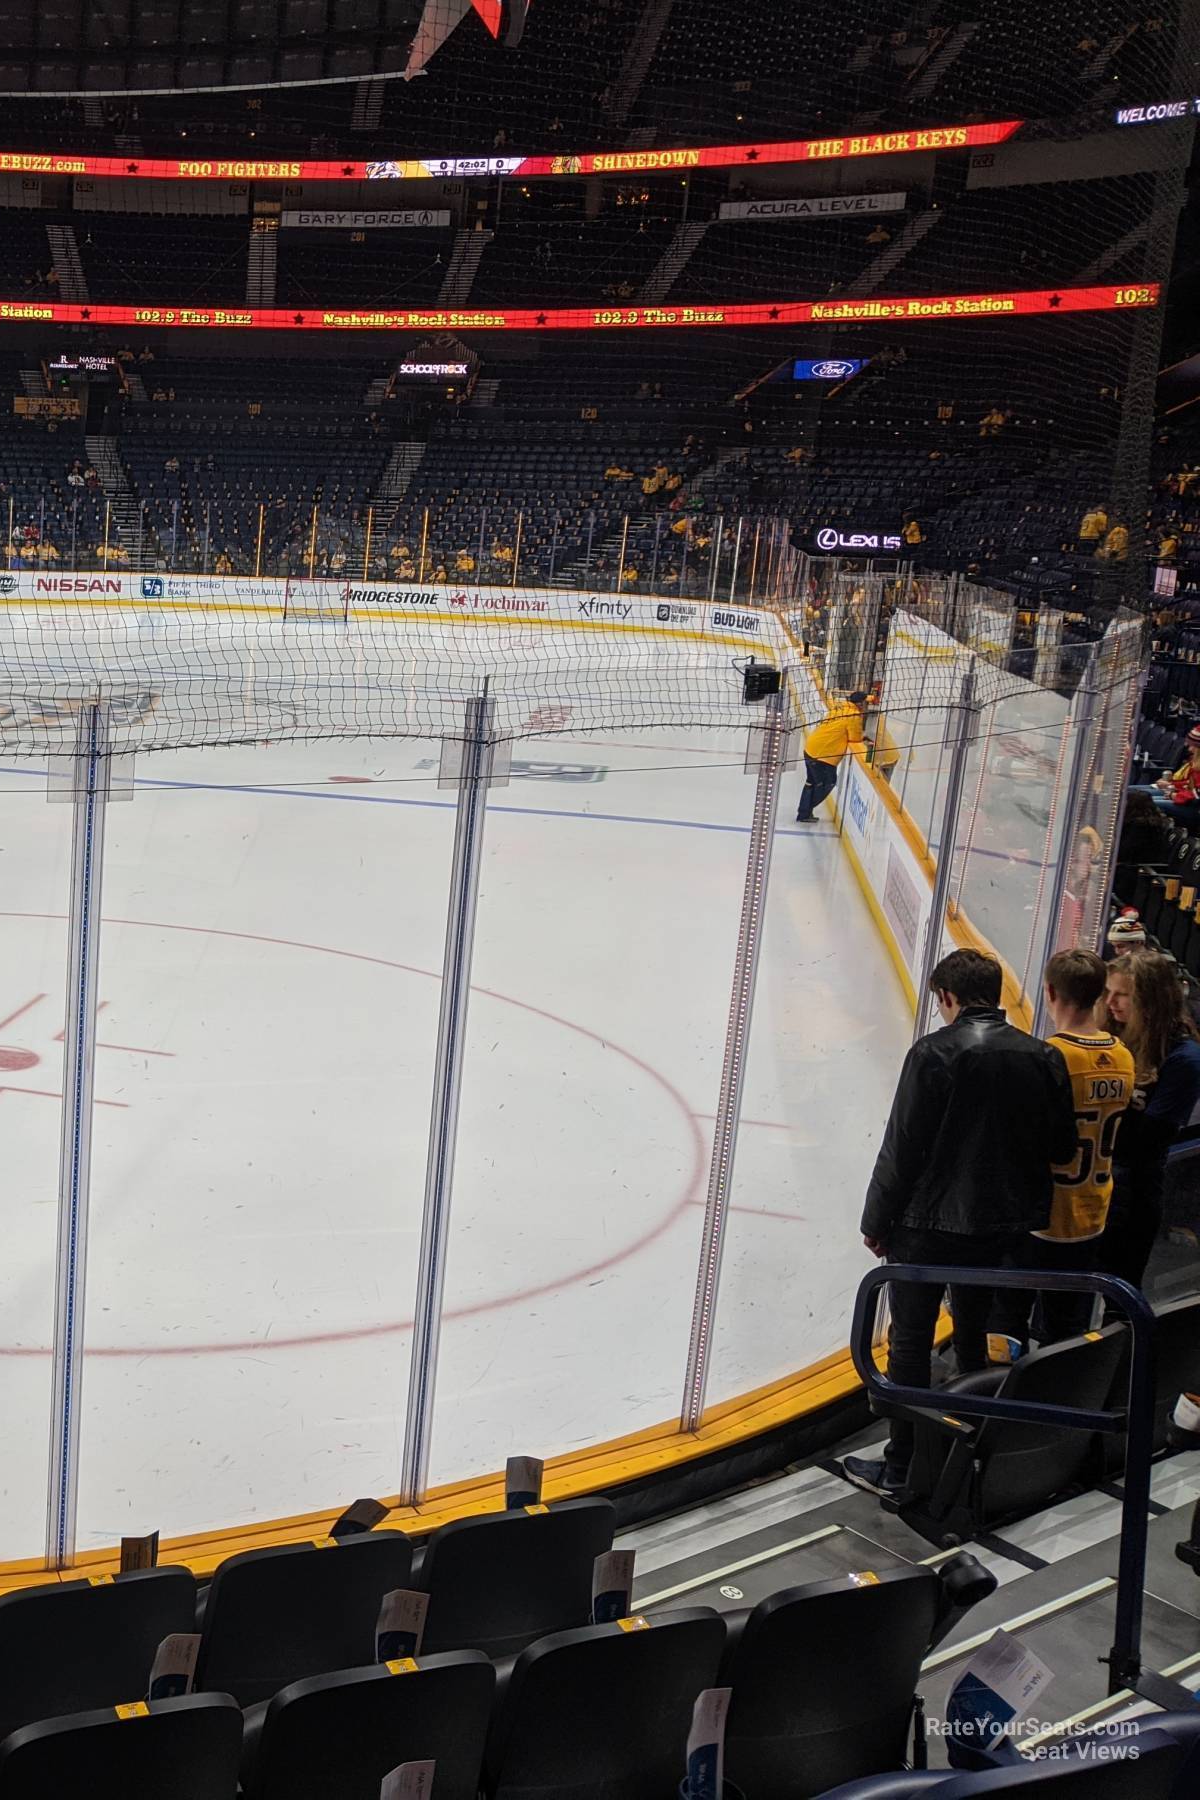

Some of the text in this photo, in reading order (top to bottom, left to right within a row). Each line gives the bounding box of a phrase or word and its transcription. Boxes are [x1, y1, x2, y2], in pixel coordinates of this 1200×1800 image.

[1117, 102, 1188, 124] WELCOME
[807, 128, 968, 158] THE BLACK KEYS
[0, 154, 301, 177] EBUZZ.com FOO FIGHTERS
[439, 159, 504, 170] 0 42:02 0
[592, 150, 700, 170] SHINEDOWN
[746, 198, 879, 215] ACURA LEVEL
[298, 214, 414, 224] GARY FORCE
[0, 305, 53, 319] Station
[643, 310, 677, 323] The
[681, 309, 725, 322] Buzz
[810, 298, 1014, 319] Nashville's Rock Station
[135, 311, 253, 325] 102.9 The Buzz
[322, 313, 505, 326] Nashville's Rock Station
[79, 356, 117, 365] NASHVILLE
[85, 363, 108, 371] HOTEL
[36, 578, 122, 593] NISSAN
[340, 588, 439, 605] BRIDGESTONE
[473, 593, 549, 612] Lochinvar
[578, 596, 632, 620] xfinity
[713, 611, 760, 632] BUD LIGHT
[1089, 1079, 1124, 1100] JOSI
